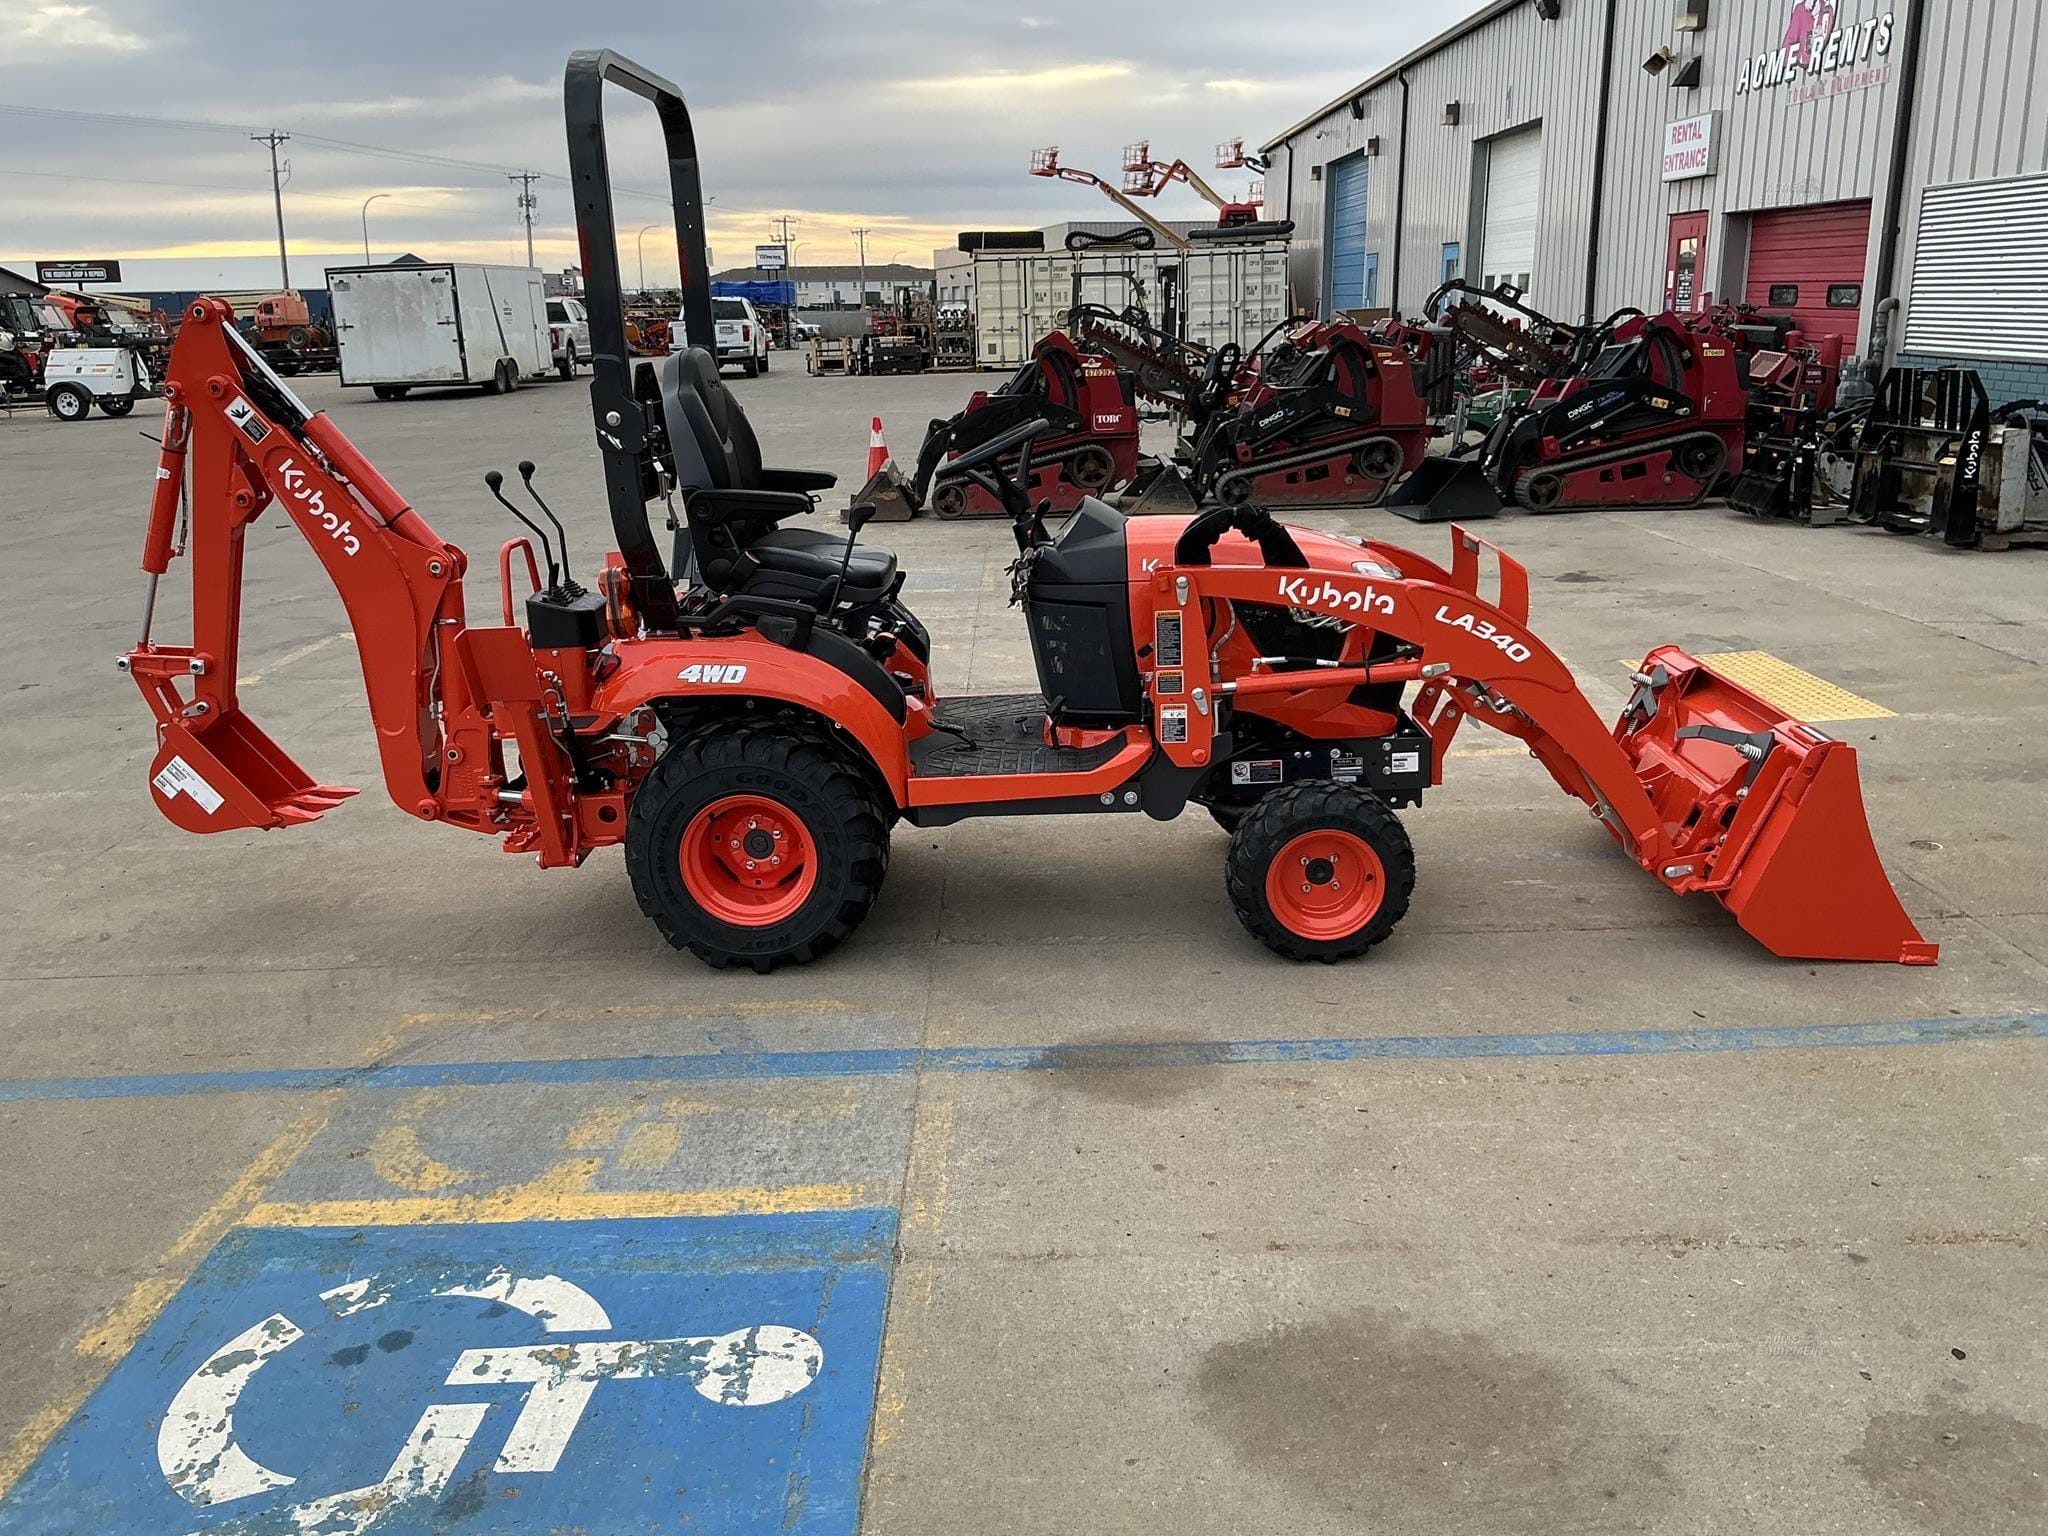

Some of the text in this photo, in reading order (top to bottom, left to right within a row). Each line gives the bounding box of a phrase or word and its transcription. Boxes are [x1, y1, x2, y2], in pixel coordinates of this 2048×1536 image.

[1736, 12, 1894, 95] ACME RENTS
[1672, 121, 1702, 145] RENTAL
[1664, 148, 1707, 172] ENTRANCE
[1258, 410, 1284, 427] DINGO
[1963, 430, 1981, 479] Kubota
[277, 458, 361, 557] Kubota
[1277, 576, 1395, 615] Kubota
[1434, 605, 1532, 664] LA340
[677, 664, 748, 685] 4WD
